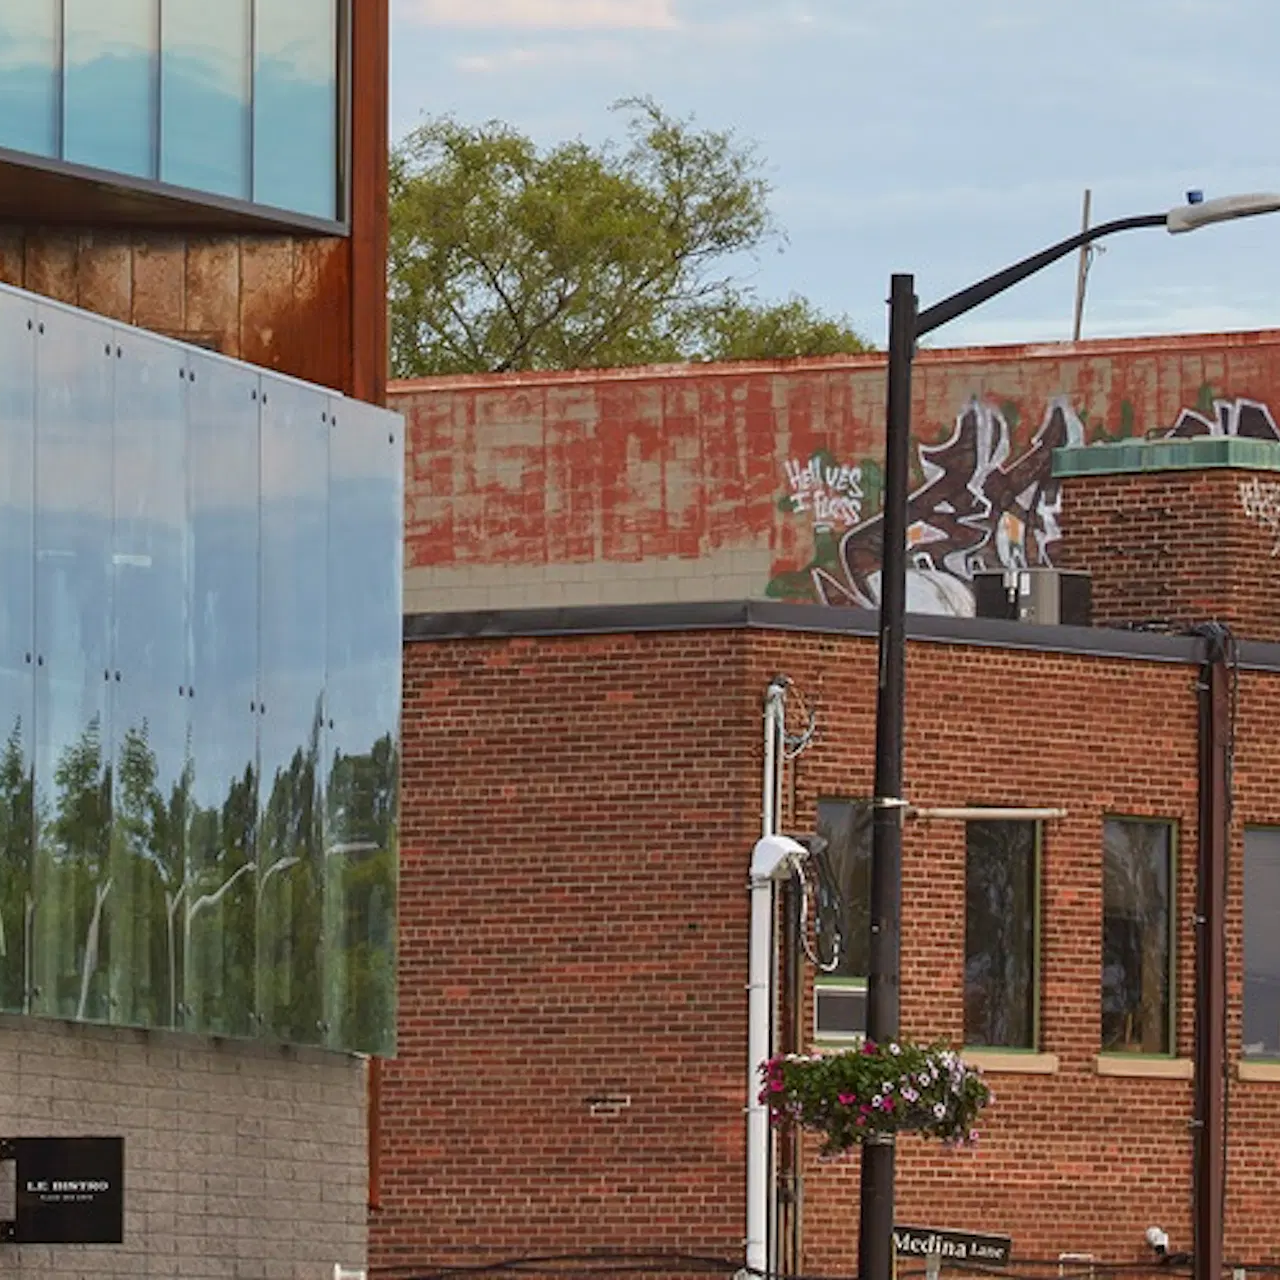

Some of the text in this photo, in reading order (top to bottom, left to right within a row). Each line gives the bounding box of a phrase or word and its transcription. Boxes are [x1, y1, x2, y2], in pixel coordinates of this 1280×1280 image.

[27, 1181, 109, 1192] LE BISTRO
[893, 1232, 1005, 1259] Medina Lane
